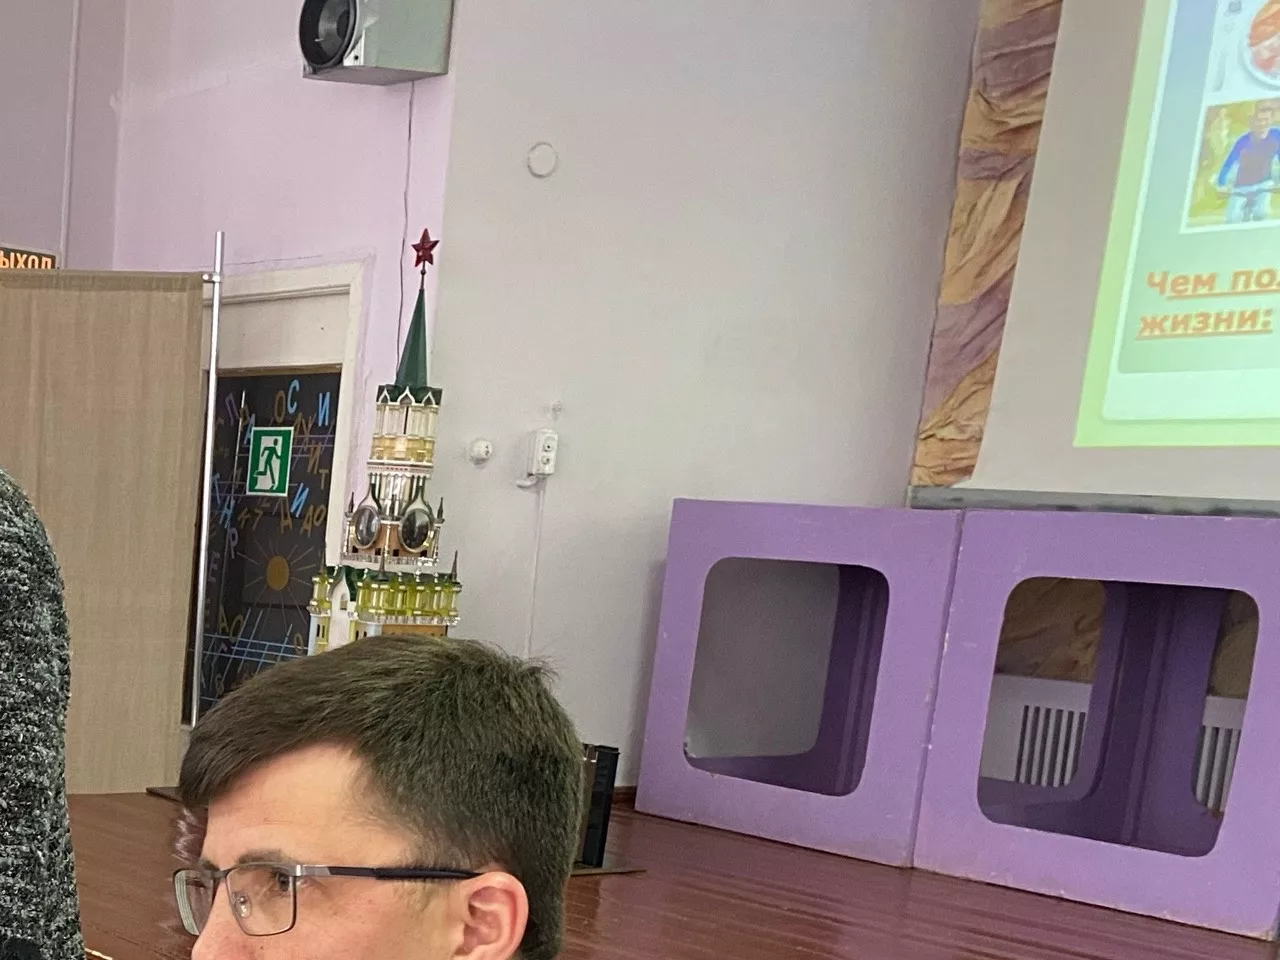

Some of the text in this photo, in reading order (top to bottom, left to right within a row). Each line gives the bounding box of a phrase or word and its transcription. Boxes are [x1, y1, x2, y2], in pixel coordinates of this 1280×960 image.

[1147, 267, 1280, 296] Чем по
[1138, 307, 1273, 336] жизни:
